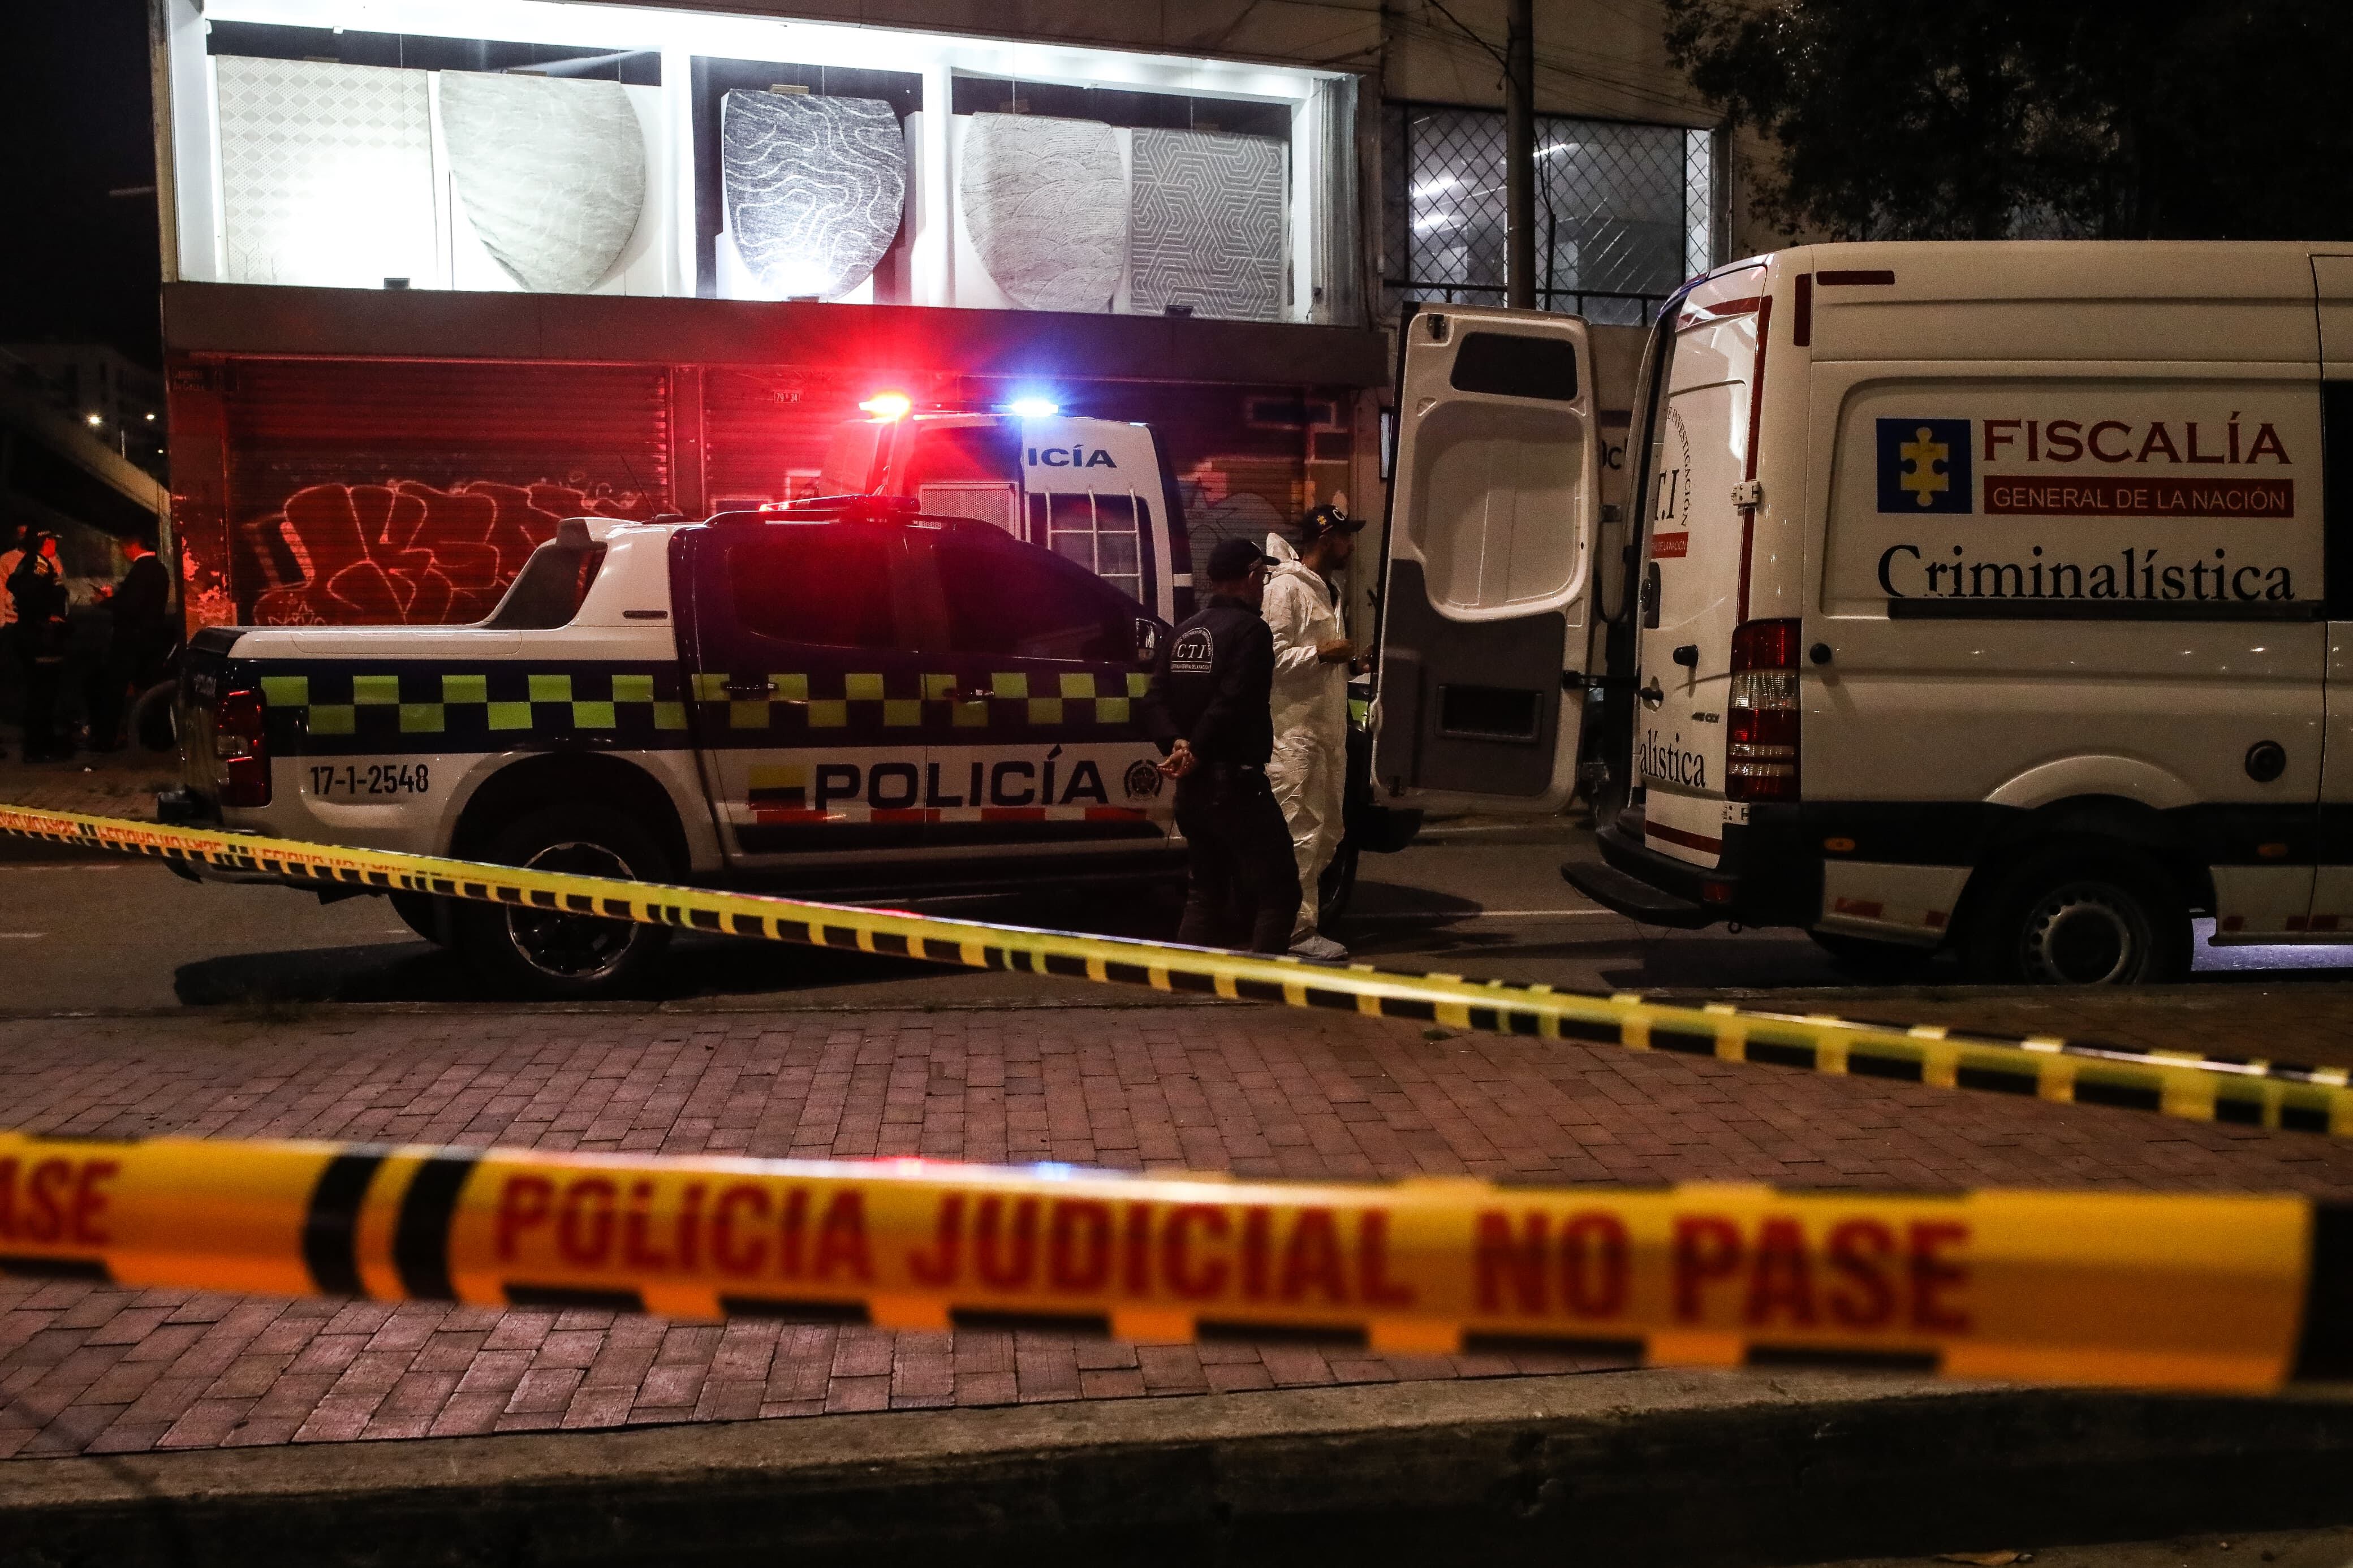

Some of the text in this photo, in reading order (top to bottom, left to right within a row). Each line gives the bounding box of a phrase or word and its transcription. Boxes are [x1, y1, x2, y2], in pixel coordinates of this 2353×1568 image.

[790, 394, 798, 402] 34
[1028, 444, 1118, 468] ICÍA
[1983, 411, 2292, 464] FISCALÍA
[1993, 485, 2285, 511] GENERAL DE LA NACIÓN
[1877, 545, 2295, 601] Criminalística
[310, 764, 429, 795] 17-1-2548
[815, 745, 1109, 810] POLICÍA
[1640, 728, 1706, 788] alística
[908, 1191, 1420, 1308] JUDICIAL
[1474, 1208, 1631, 1320] NO
[1673, 1211, 1974, 1333] PASE
